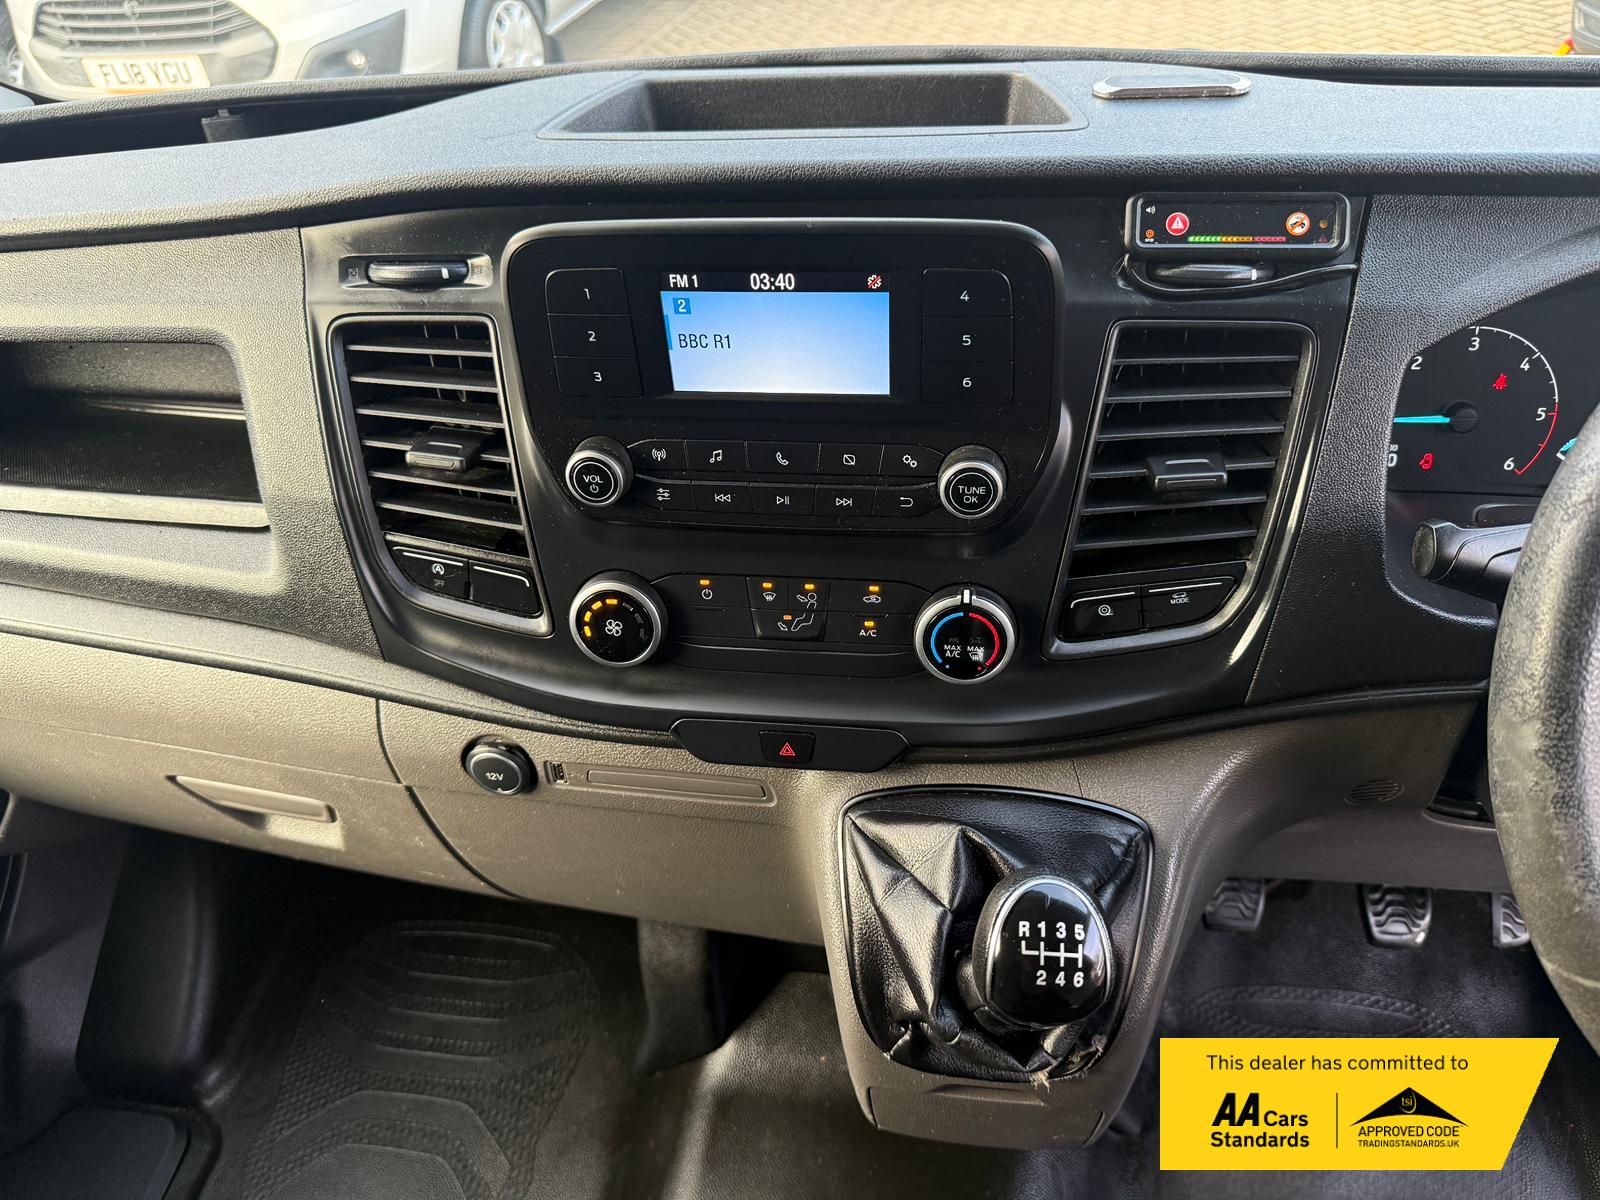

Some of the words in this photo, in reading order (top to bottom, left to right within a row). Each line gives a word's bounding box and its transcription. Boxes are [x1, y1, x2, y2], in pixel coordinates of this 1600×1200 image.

[97, 62, 146, 85] FL18
[669, 274, 688, 288] FM
[691, 274, 699, 288] 1
[750, 273, 795, 290] 03:40
[583, 288, 591, 299] 1
[959, 290, 970, 302] 4
[678, 299, 687, 312] 2
[587, 331, 597, 342] 2
[678, 333, 709, 349] BBC
[713, 334, 731, 349] R1
[962, 335, 972, 346] 5
[1468, 337, 1480, 351] 3
[1411, 356, 1423, 370] 2
[1520, 357, 1530, 371] 4
[593, 371, 603, 382] 3
[962, 377, 972, 388] 6
[1535, 407, 1547, 421] 5
[1503, 457, 1515, 471] 6
[582, 474, 604, 483] VOL
[957, 485, 987, 495] TUNE
[963, 495, 979, 503] OK
[1170, 596, 1191, 604] MODE
[859, 629, 877, 637] A/C
[945, 650, 960, 658] A/C
[485, 772, 504, 781] 12V
[1018, 921, 1030, 937] R
[1037, 921, 1046, 938] 1
[1055, 921, 1067, 939] 3
[1074, 923, 1085, 940] 5
[1036, 969, 1047, 986] 2
[1054, 971, 1066, 987] 4
[1073, 971, 1084, 988] 6
